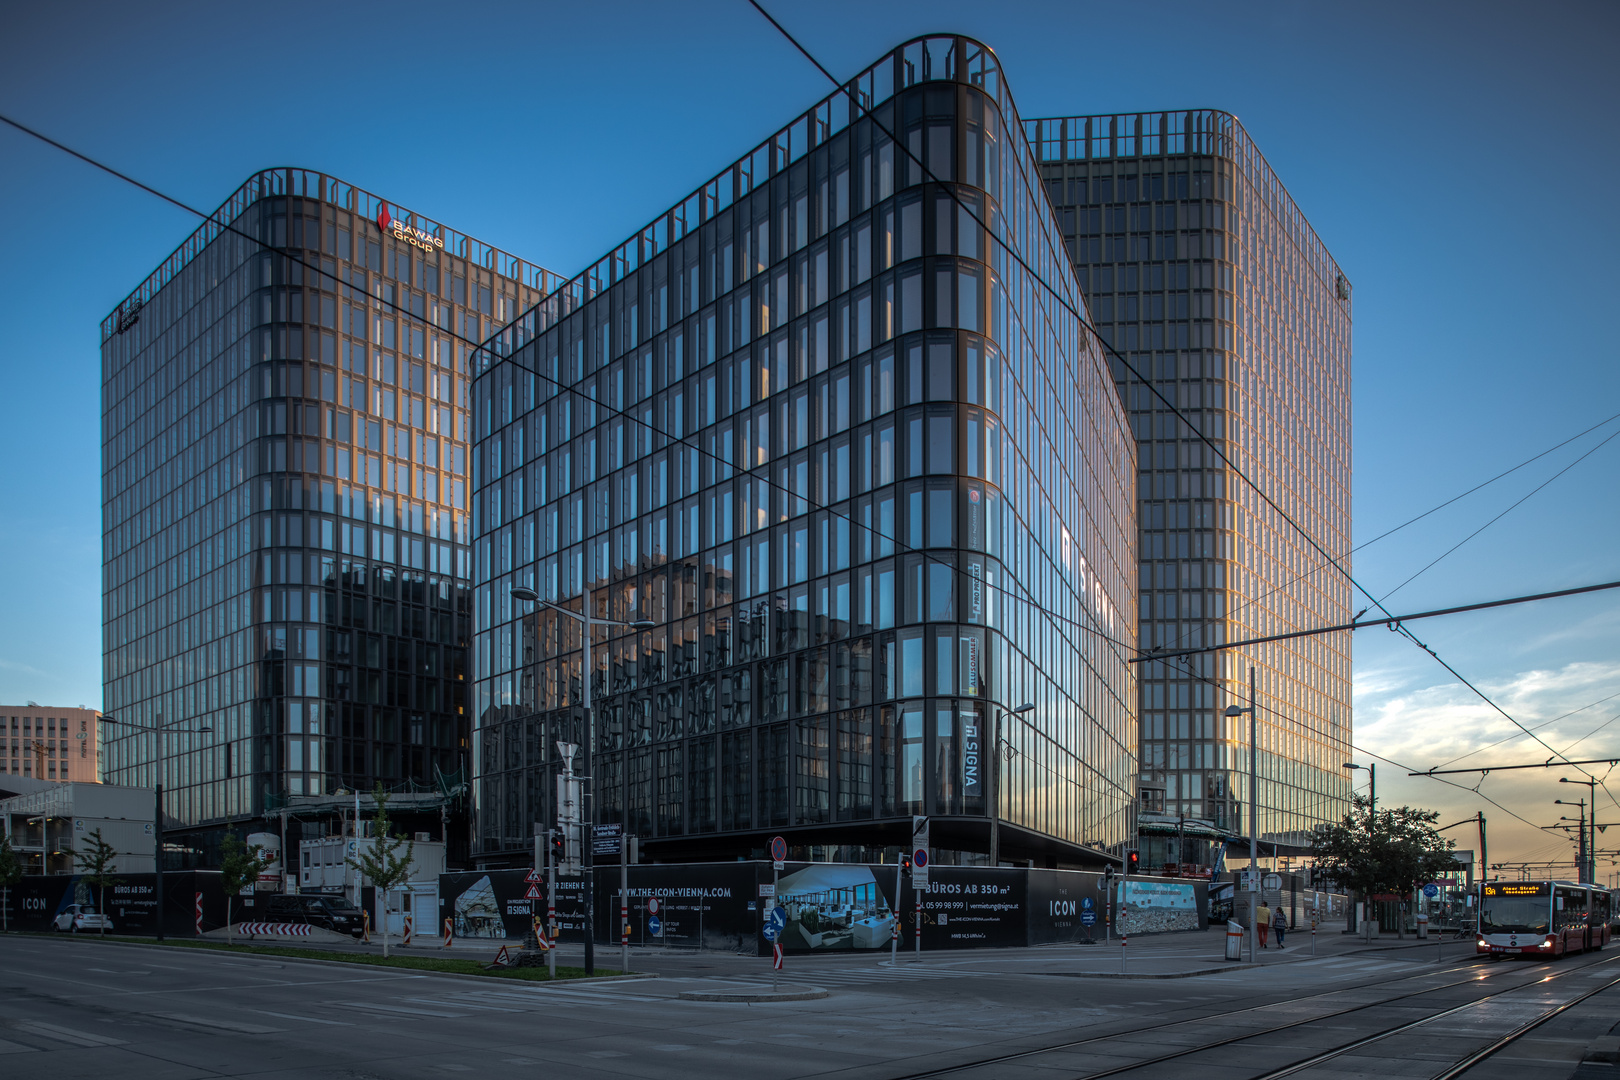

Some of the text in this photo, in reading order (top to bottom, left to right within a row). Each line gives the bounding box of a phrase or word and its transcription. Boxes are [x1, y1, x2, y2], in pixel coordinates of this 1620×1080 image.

[393, 220, 443, 248] BAWAG
[393, 230, 433, 252] Group
[965, 742, 978, 786] SIGNA
[114, 885, 130, 894] BÜROS
[617, 888, 731, 897] WWW.THE-ICON-VIENNA.COM
[925, 882, 961, 894] BÜROS
[964, 884, 978, 894] AB
[981, 885, 998, 894] 350
[1000, 886, 1010, 894] m²
[1485, 887, 1496, 895] 13A
[22, 898, 47, 910] ICON
[513, 905, 531, 915] SIGNA
[1050, 900, 1076, 916] ICON
